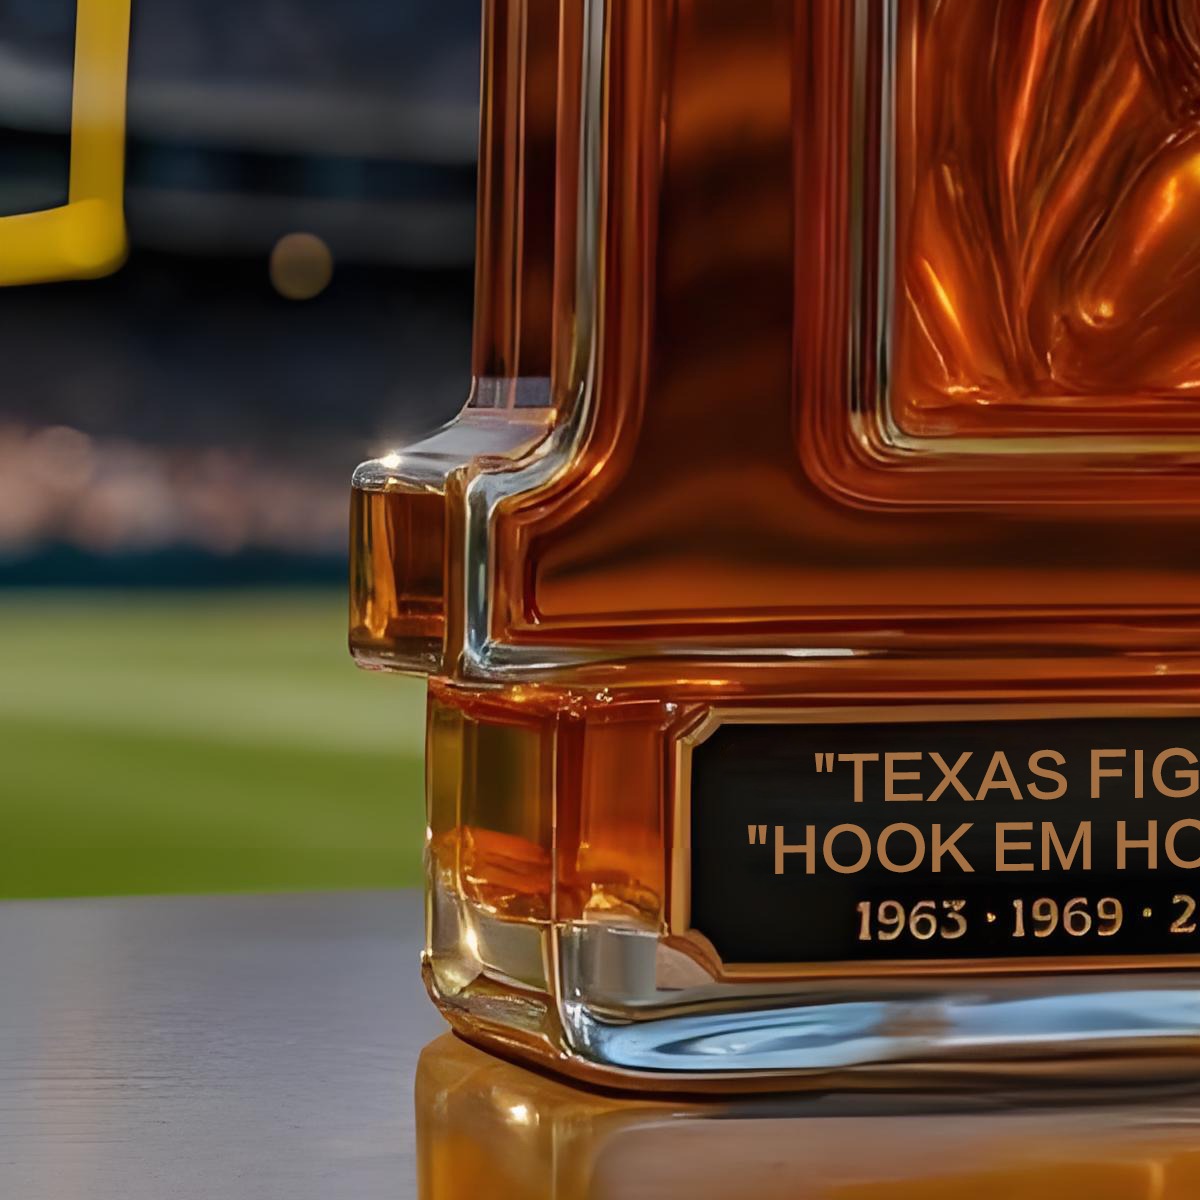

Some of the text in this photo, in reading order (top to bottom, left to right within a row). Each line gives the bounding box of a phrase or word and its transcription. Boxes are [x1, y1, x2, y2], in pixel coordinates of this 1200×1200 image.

[814, 750, 1068, 803] "TEXAS
[747, 822, 976, 875] "HOOK
[995, 820, 1093, 872] EM
[857, 900, 968, 941] 1963
[1012, 897, 1124, 938] 1969
